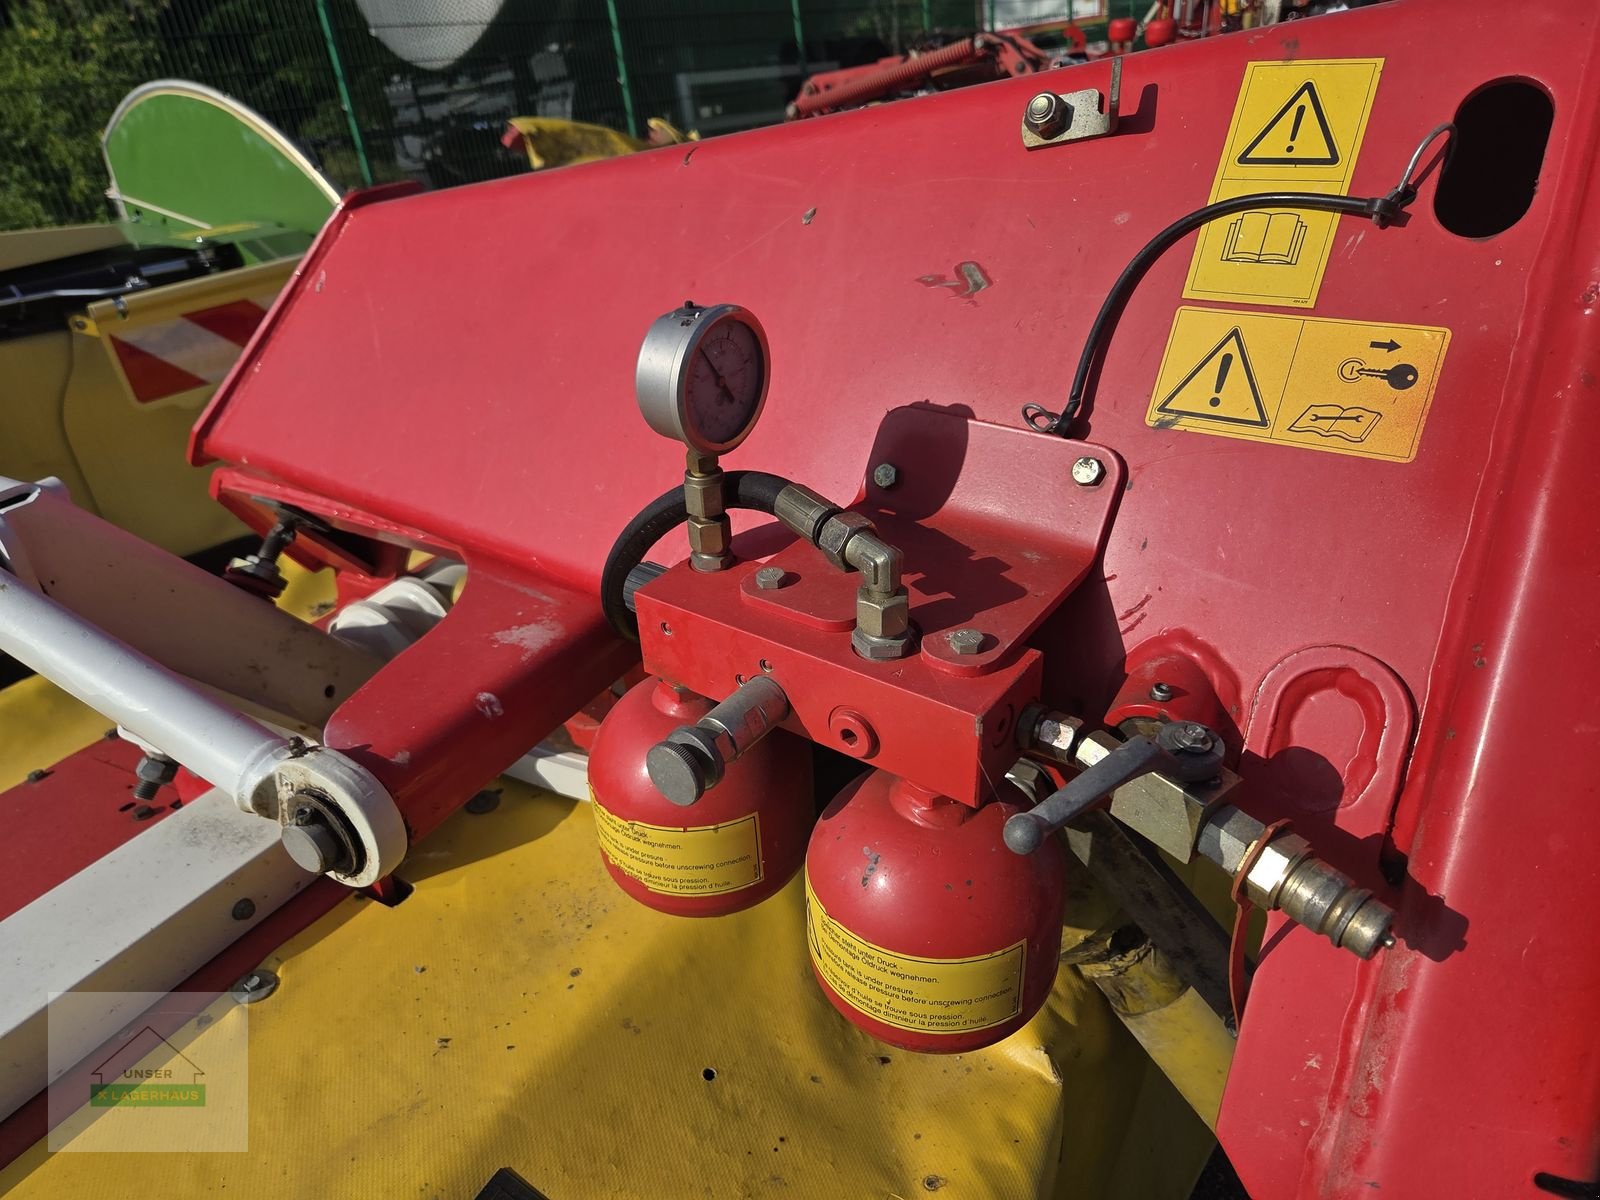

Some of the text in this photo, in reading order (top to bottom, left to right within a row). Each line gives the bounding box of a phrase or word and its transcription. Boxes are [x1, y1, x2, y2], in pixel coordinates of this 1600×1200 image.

[654, 861, 675, 870] before
[858, 948, 875, 961] unter
[877, 956, 898, 969] Druck
[842, 958, 855, 973] tank
[856, 968, 863, 977] is
[864, 973, 884, 986] under
[885, 983, 914, 996] presure
[890, 970, 940, 984] wegnehmen.
[869, 983, 900, 1001] pressure
[902, 995, 926, 1005] before
[928, 998, 972, 1006] unscrewing
[874, 999, 884, 1008] se
[884, 1002, 907, 1016] trouve
[909, 1010, 928, 1018] sous
[918, 1018, 926, 1026] la
